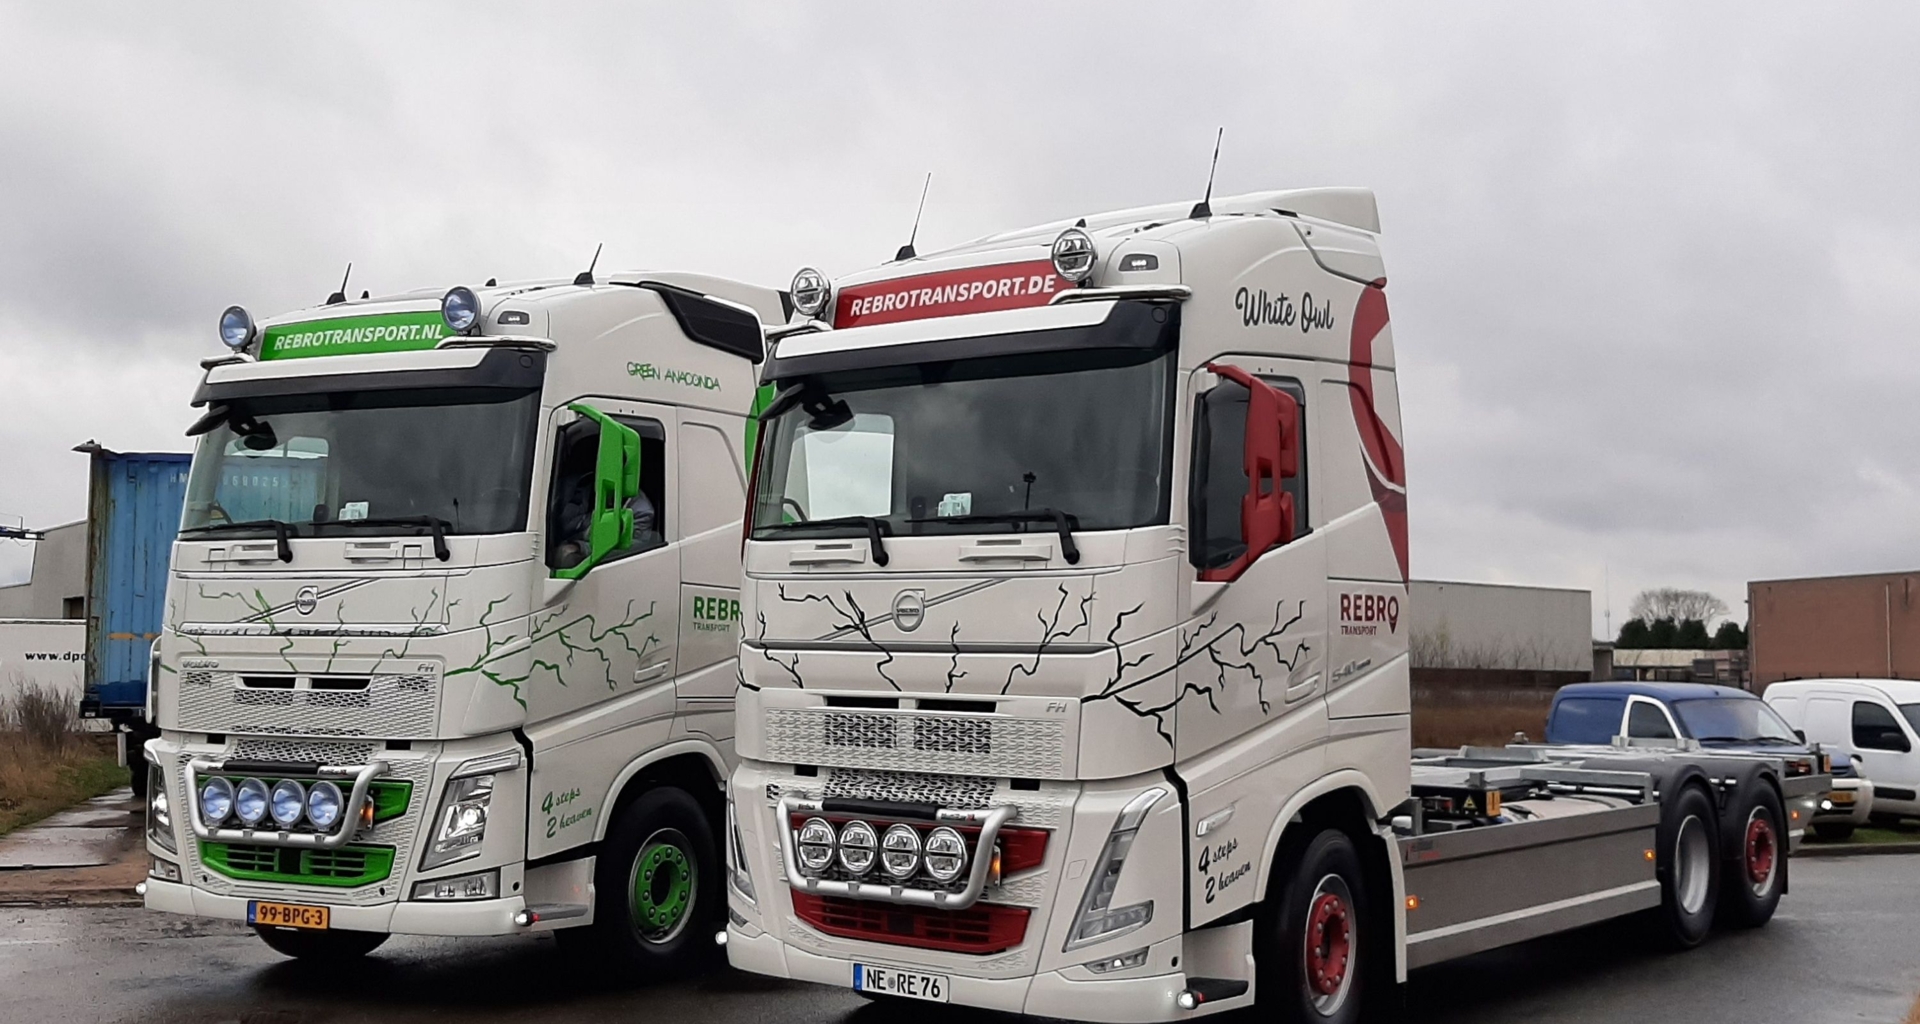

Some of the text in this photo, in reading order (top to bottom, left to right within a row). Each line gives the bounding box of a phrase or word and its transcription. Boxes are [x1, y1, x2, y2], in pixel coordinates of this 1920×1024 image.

[850, 274, 1056, 317] REBROTRANSPORT.DE
[1235, 286, 1335, 333] White Owl
[274, 324, 443, 350] REBROTRANSPORT.NL
[627, 361, 721, 392] GREEN ANACONDA
[692, 621, 730, 632] TRANSPORT
[1340, 593, 1399, 634] REBRO
[1340, 625, 1377, 635] TRANSPORT
[1046, 702, 1067, 713] FH
[541, 788, 580, 815] 4 steps
[546, 807, 592, 838] 2 heaven
[1198, 838, 1238, 875] 4 steps
[1205, 861, 1251, 904] 2 heaven
[260, 905, 323, 926] 99-BPG-3
[866, 968, 940, 998] NE RE 76
